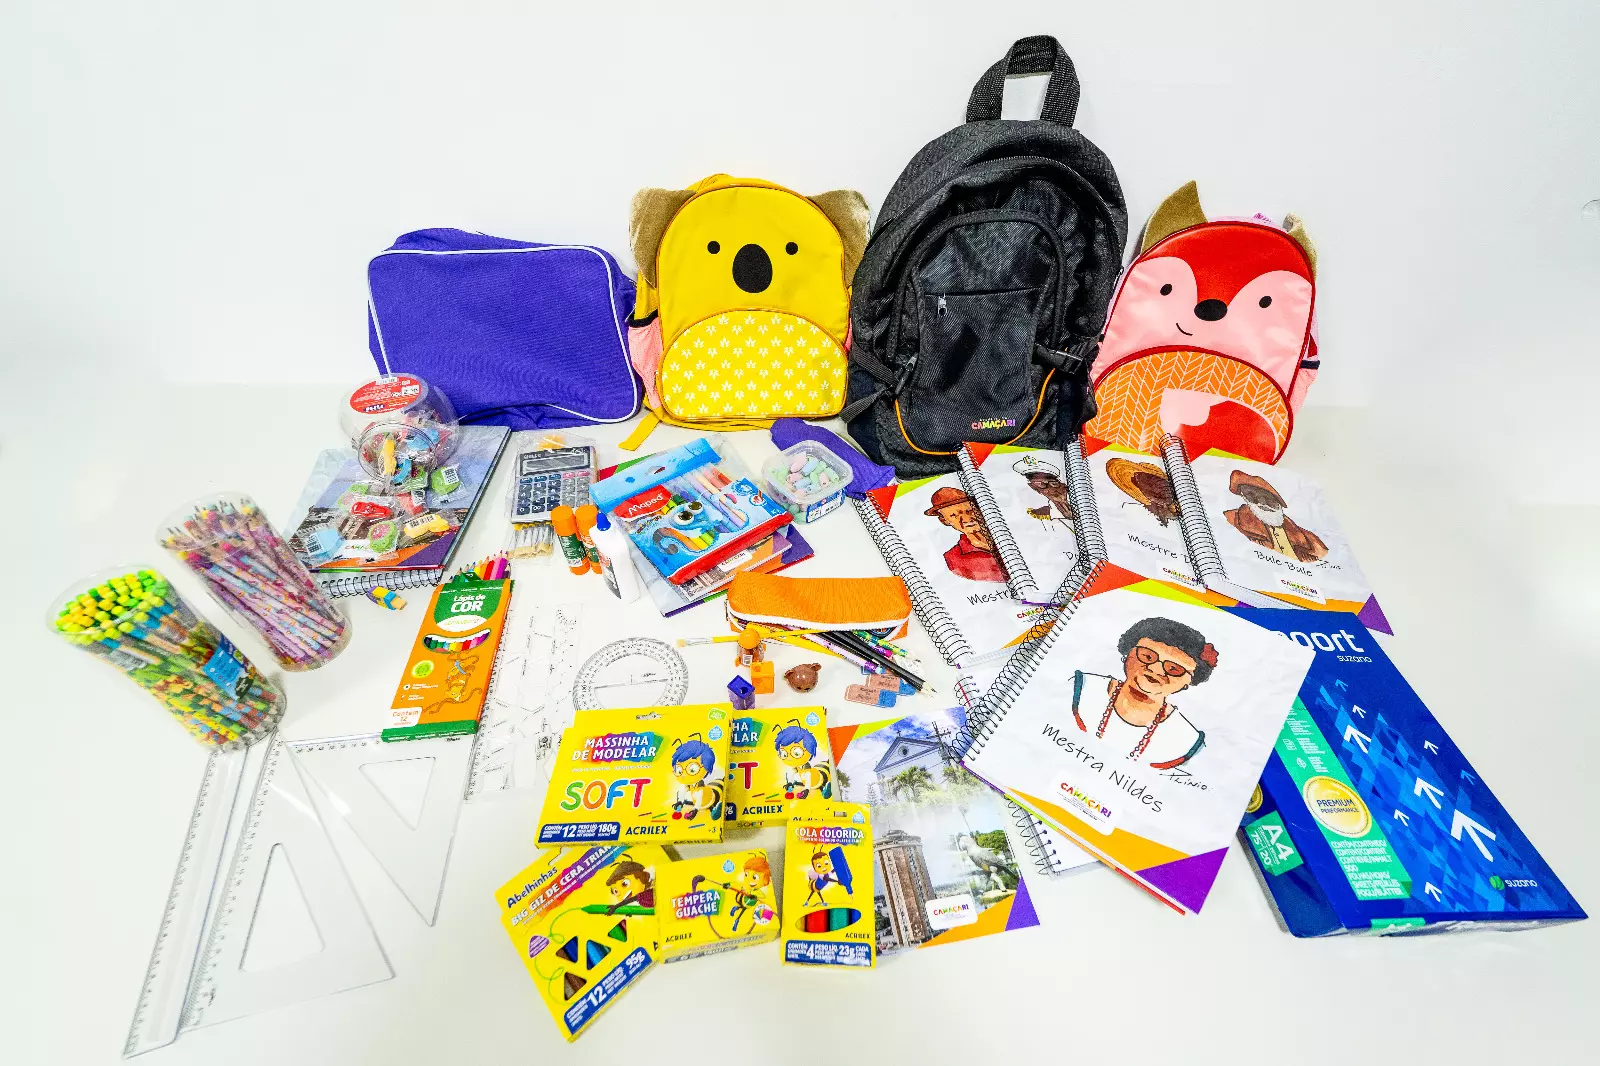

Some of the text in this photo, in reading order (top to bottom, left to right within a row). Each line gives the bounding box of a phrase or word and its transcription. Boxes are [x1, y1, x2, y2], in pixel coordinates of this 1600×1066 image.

[628, 493, 664, 516] Maped
[1127, 533, 1178, 559] Mestre
[967, 589, 1013, 606] Mestr
[450, 600, 484, 613] COR
[1337, 655, 1373, 663] suzano
[584, 736, 649, 749] MASSINHA
[572, 746, 657, 761] DE MODELAR
[1042, 723, 1104, 773] Mestra
[1108, 770, 1164, 813] Nildes
[560, 777, 652, 811] SOFT
[742, 805, 783, 816] ACRILEX
[562, 825, 577, 838] 12
[597, 823, 618, 835] 180g
[625, 825, 668, 836] ACRILEX
[794, 827, 865, 839] COLA COLORIDA
[1262, 825, 1294, 861] A4
[507, 866, 558, 909] Abelhinhas
[1504, 879, 1538, 888] suzano
[511, 909, 529, 926] BIG
[529, 894, 546, 911] GIZ
[545, 883, 561, 897] DE
[560, 864, 585, 886] CERA
[671, 889, 721, 908] TEMPERA
[675, 901, 718, 919] GUACHE
[665, 932, 693, 943] ACRILEX
[806, 944, 815, 960] 4
[838, 945, 855, 959] 23g
[587, 985, 607, 1007] 12
[625, 950, 646, 970] 95g
